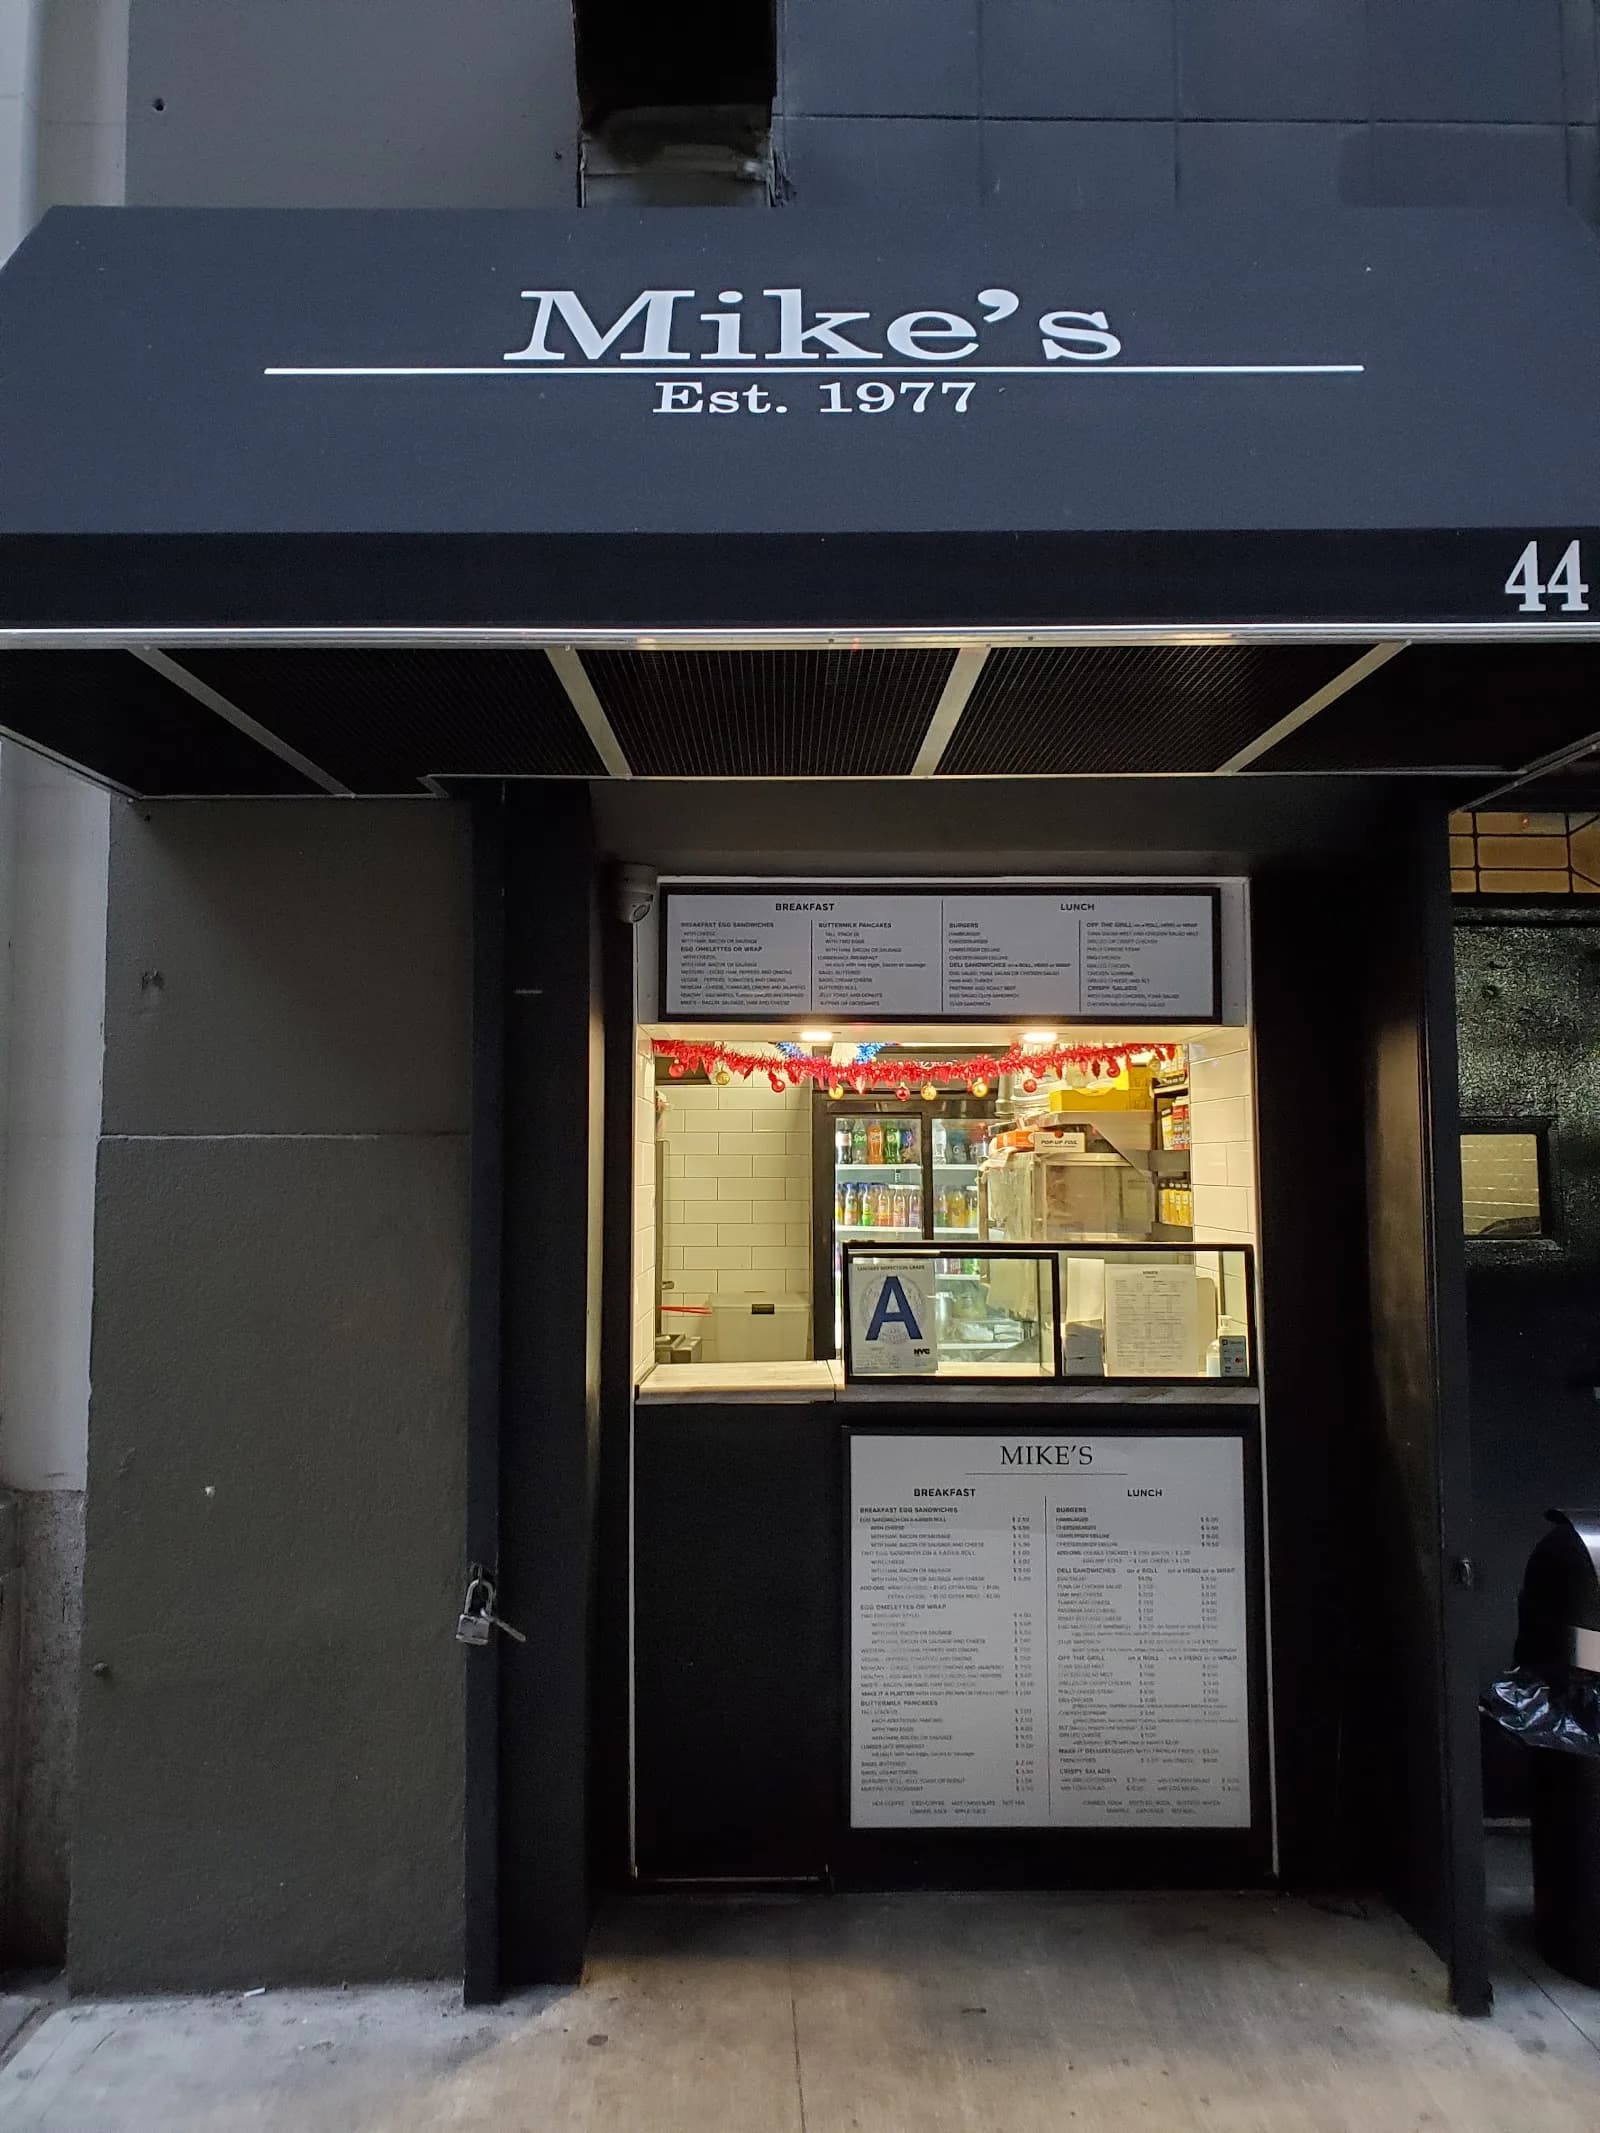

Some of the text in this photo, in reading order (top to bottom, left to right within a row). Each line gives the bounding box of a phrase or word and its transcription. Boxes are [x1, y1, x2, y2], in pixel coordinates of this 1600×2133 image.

[503, 288, 1122, 361] Mike's
[652, 381, 976, 414] Est. 1977
[1504, 540, 1589, 611] 44
[775, 902, 835, 912] BREAKFAST
[1060, 902, 1095, 912] LUNCH
[865, 1276, 923, 1340] A
[1000, 1445, 1094, 1466] MIKE'S
[914, 1488, 976, 1497] BREAKFAST
[1127, 1489, 1162, 1497] LUNCH
